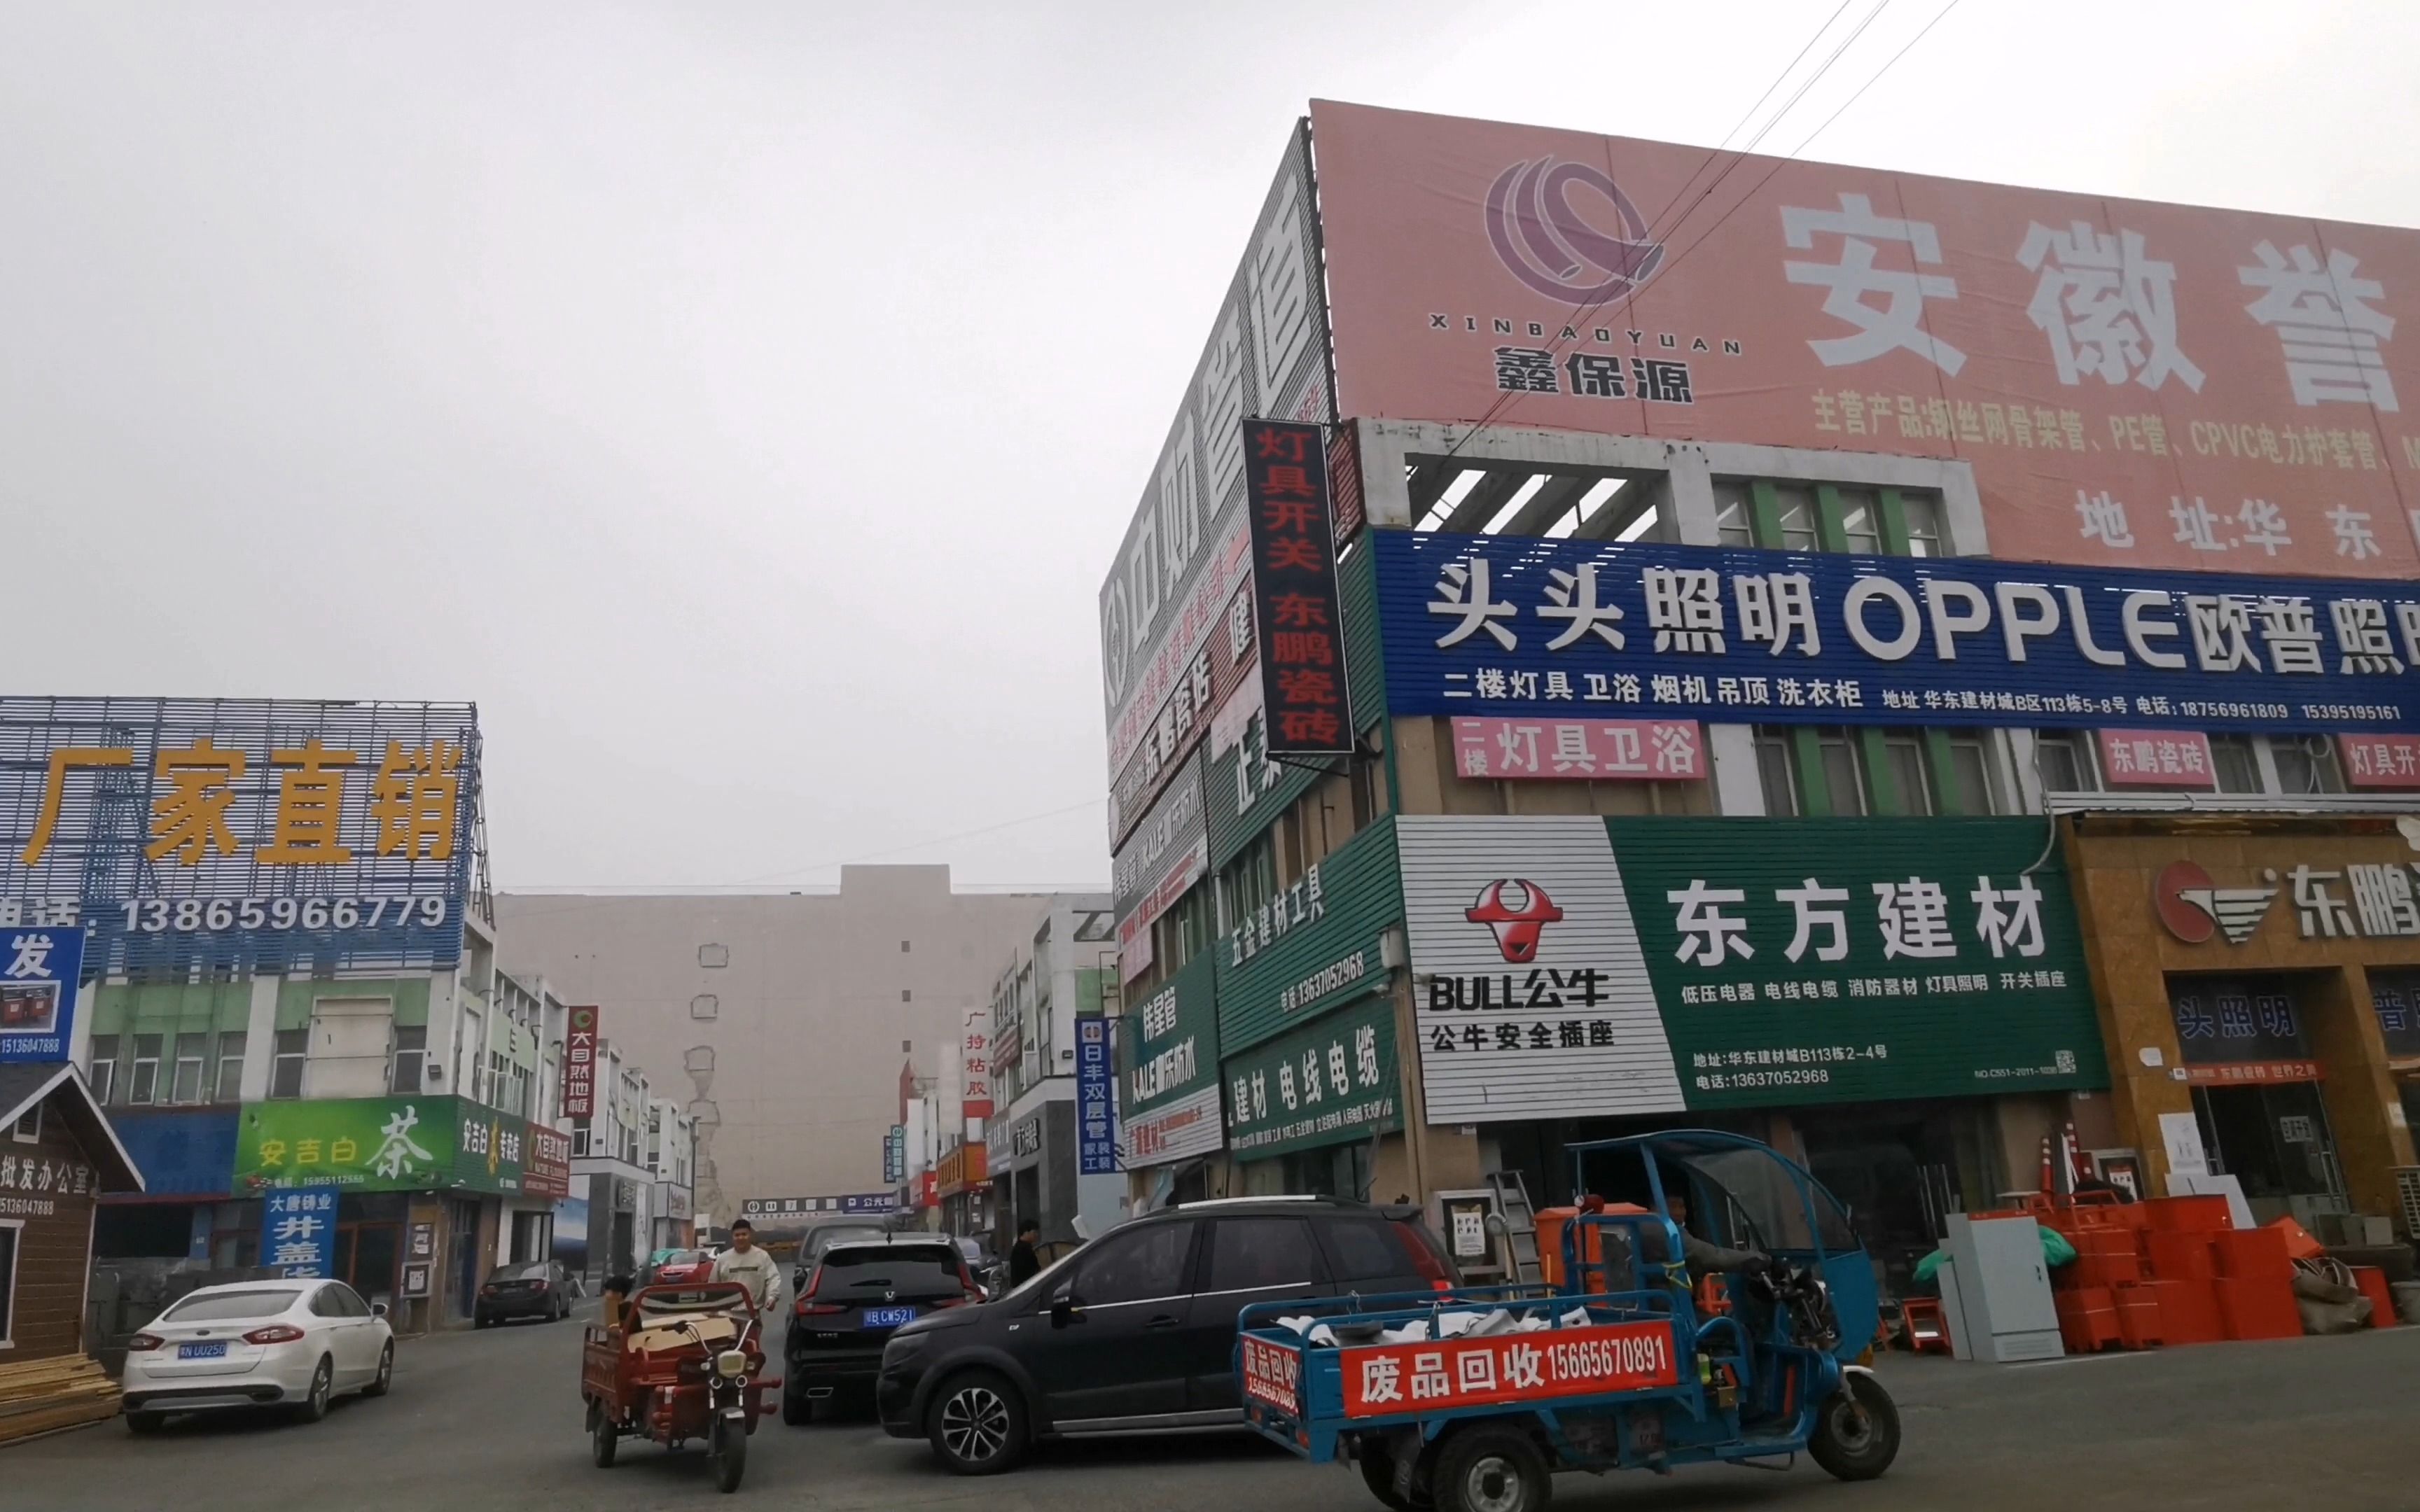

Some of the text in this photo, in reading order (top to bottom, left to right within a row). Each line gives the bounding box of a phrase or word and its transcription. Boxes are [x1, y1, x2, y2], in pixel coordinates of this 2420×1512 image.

[1429, 313, 1742, 356] XINBAOYUAN
[1493, 346, 1693, 403] 鑫保源
[1256, 428, 1339, 744] 灯具开关 东鹏瓷砖
[1427, 559, 1821, 657] 头头照明
[1444, 668, 1863, 707] 二楼灯具 卫浴 烟机 吊顶 洗衣柜
[1882, 690, 1920, 709] 地址
[1461, 721, 1488, 777] 二楼
[1496, 723, 1697, 774] 灯具卫浴
[2110, 738, 2204, 774] 东鹏瓷砖
[2350, 743, 2420, 776] 灯具开
[20, 737, 462, 867] 厂家直销
[1232, 864, 1324, 967] 五金建材工具
[1667, 875, 2046, 967] 东方建材
[2287, 862, 2420, 936] 东鹏
[4, 934, 54, 978] 发
[1681, 970, 2067, 1004] 低压电器 电线电缆 消防器材 灯具照明 开关插座
[1430, 1020, 1615, 1051] 公牛安全插座
[568, 1031, 592, 1114] 大自然地板
[1083, 1045, 1105, 1140] 日丰双层管
[1, 1155, 89, 1194] 批发办公室
[0, 1198, 54, 1215] 5136047888
[1244, 1339, 1297, 1389] 废品回收
[1361, 1335, 1666, 1403] 废品回收 15665670891
[1248, 1376, 1299, 1413] 1566567089
